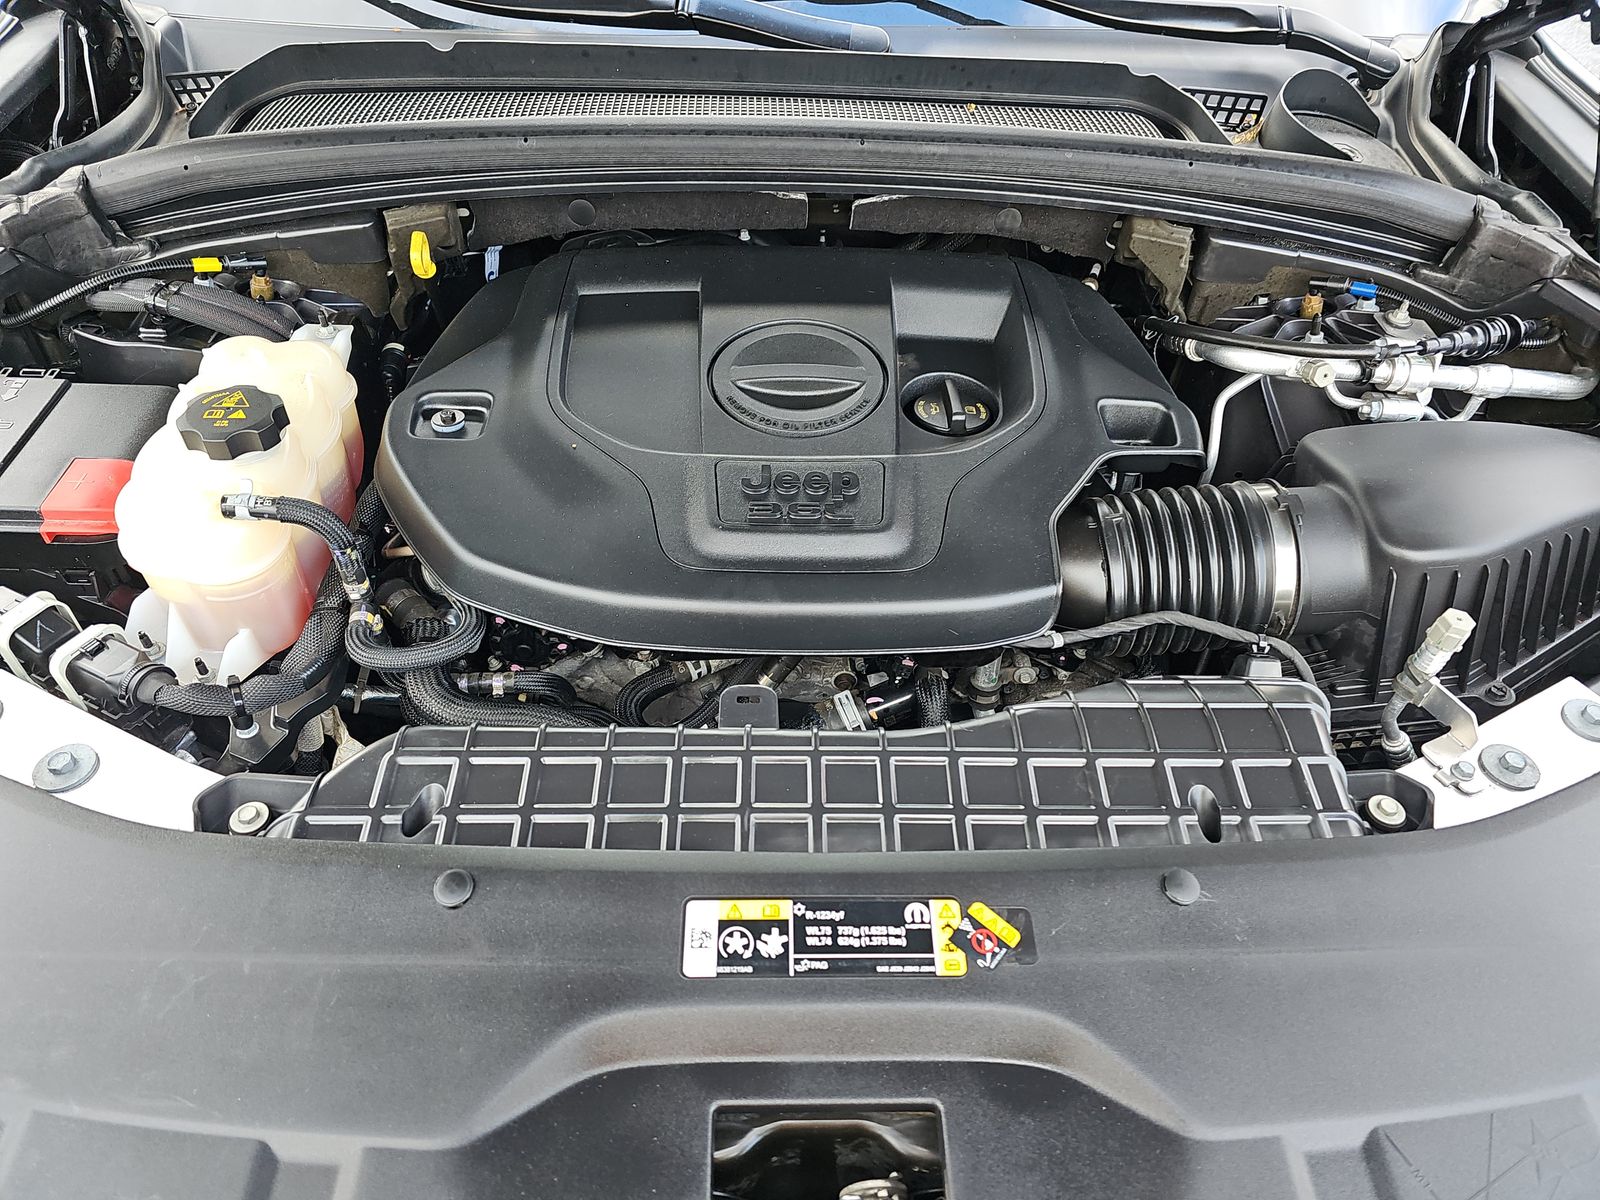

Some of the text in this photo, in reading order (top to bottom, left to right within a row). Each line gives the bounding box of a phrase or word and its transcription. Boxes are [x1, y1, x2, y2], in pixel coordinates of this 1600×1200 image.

[782, 422, 799, 430] OIL
[740, 464, 862, 501] Jeep
[804, 910, 846, 922] R-1234yf
[804, 925, 833, 936] WL75
[836, 925, 860, 937] 737g
[804, 936, 833, 947] WL74
